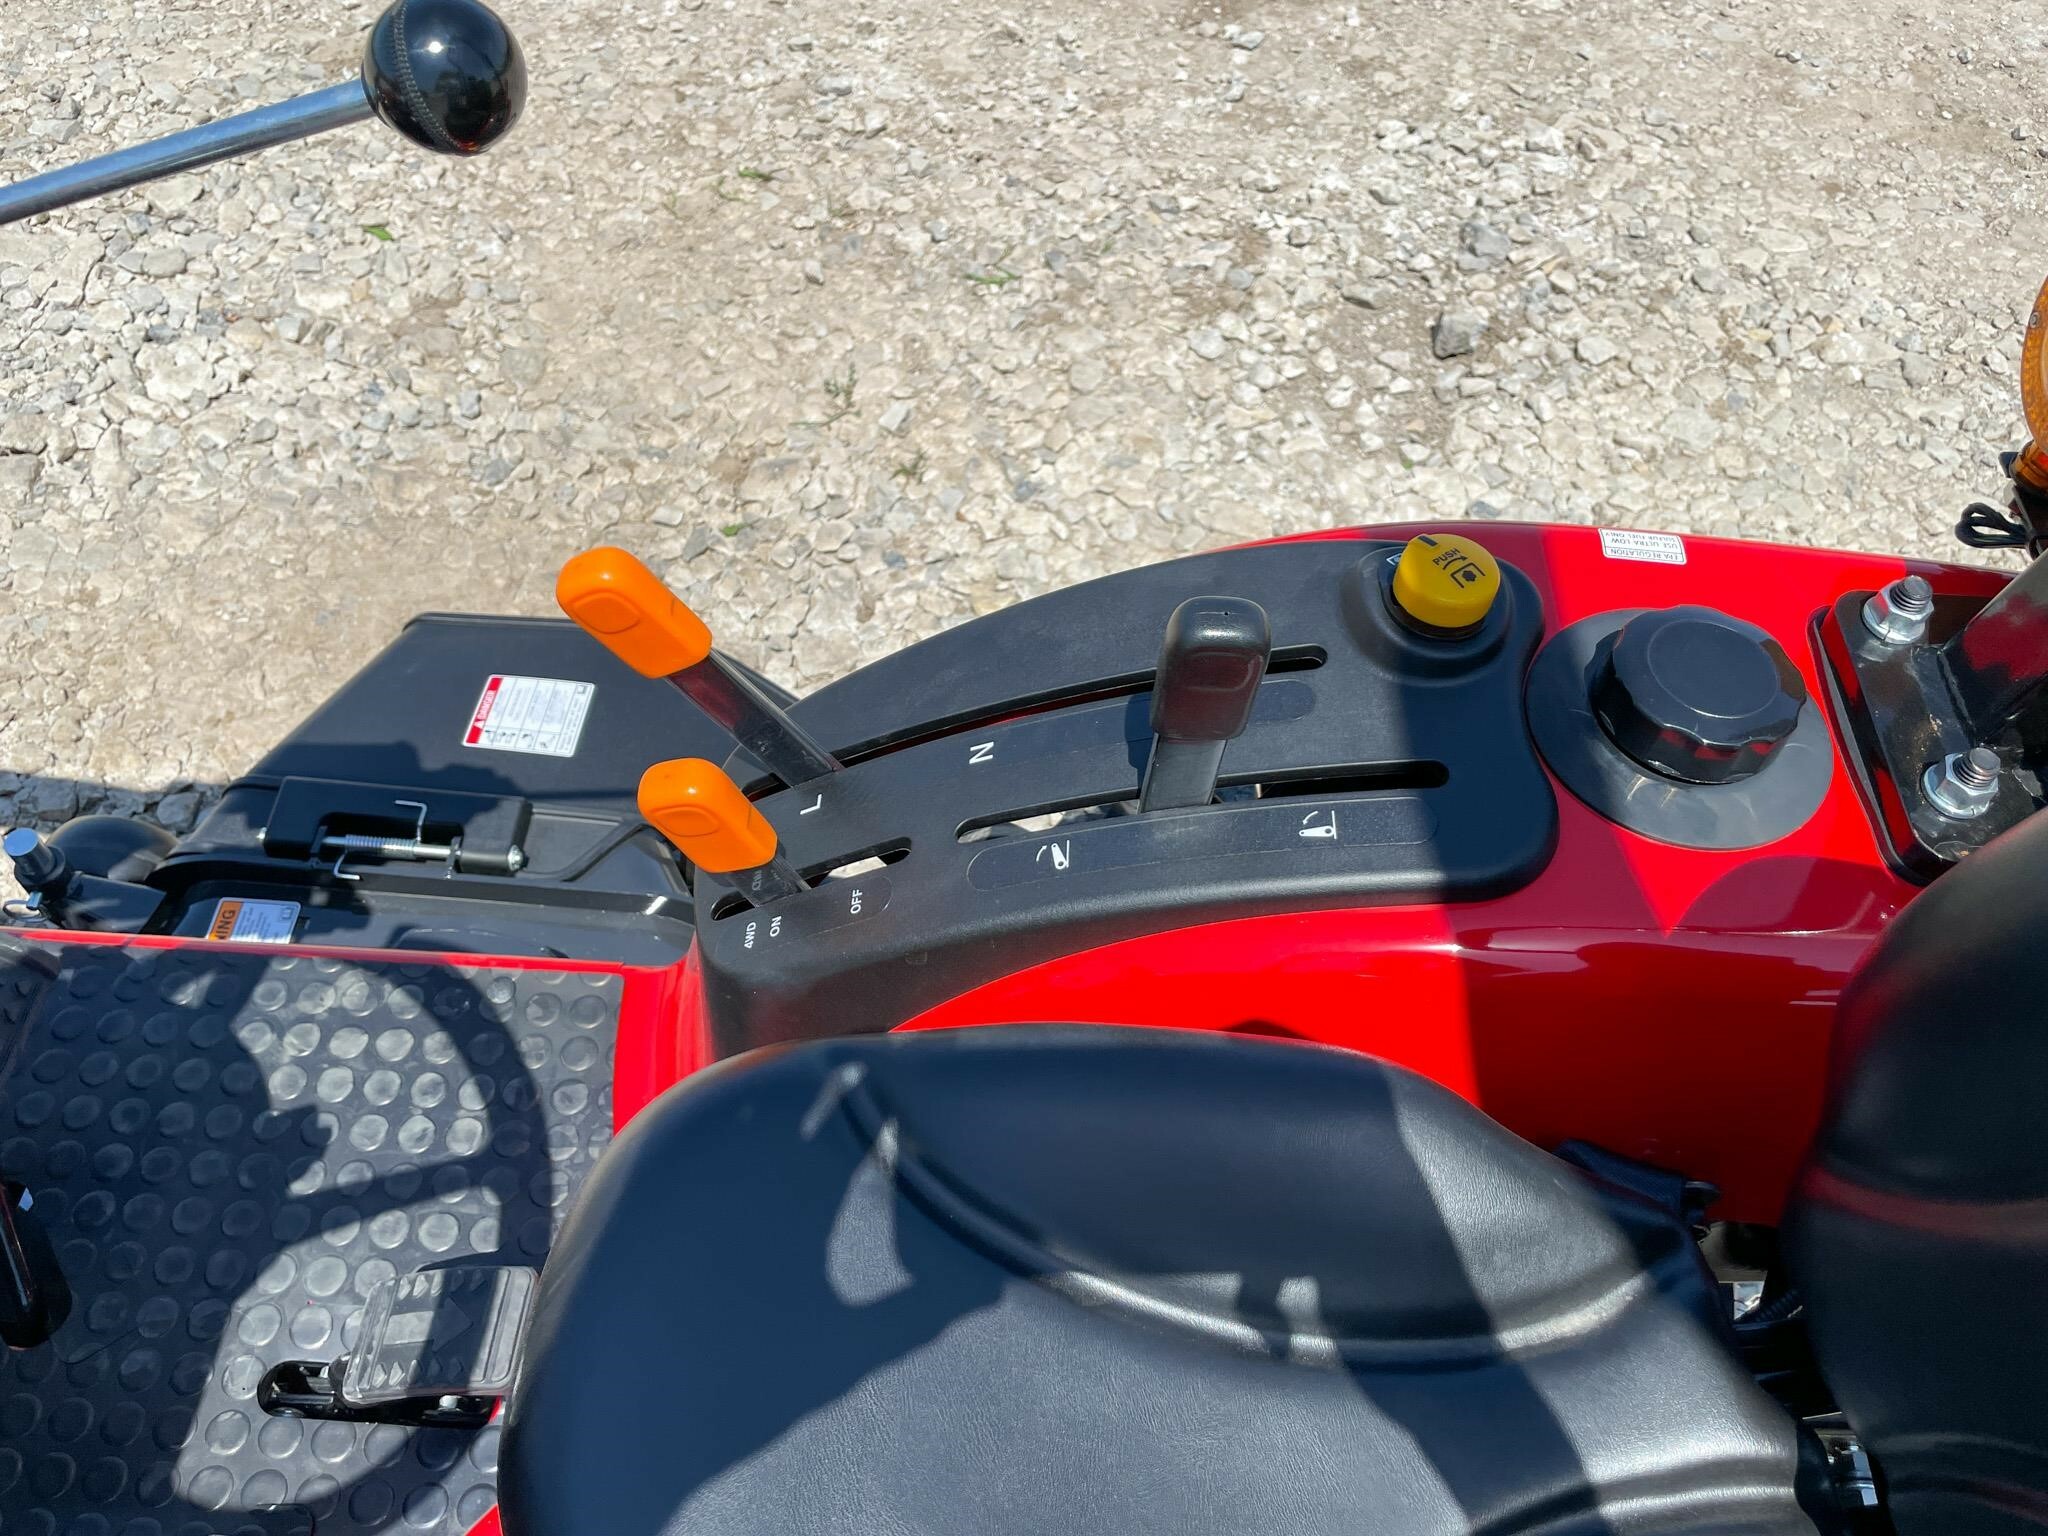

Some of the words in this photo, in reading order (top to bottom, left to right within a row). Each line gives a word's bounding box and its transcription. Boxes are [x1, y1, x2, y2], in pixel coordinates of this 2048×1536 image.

[1432, 548, 1461, 566] PUSH
[1611, 548, 1662, 559] REGULATION
[968, 741, 994, 765] N
[800, 793, 822, 815] L
[850, 889, 863, 914] OFF
[743, 921, 757, 949] 4WD
[769, 915, 782, 938] ON
